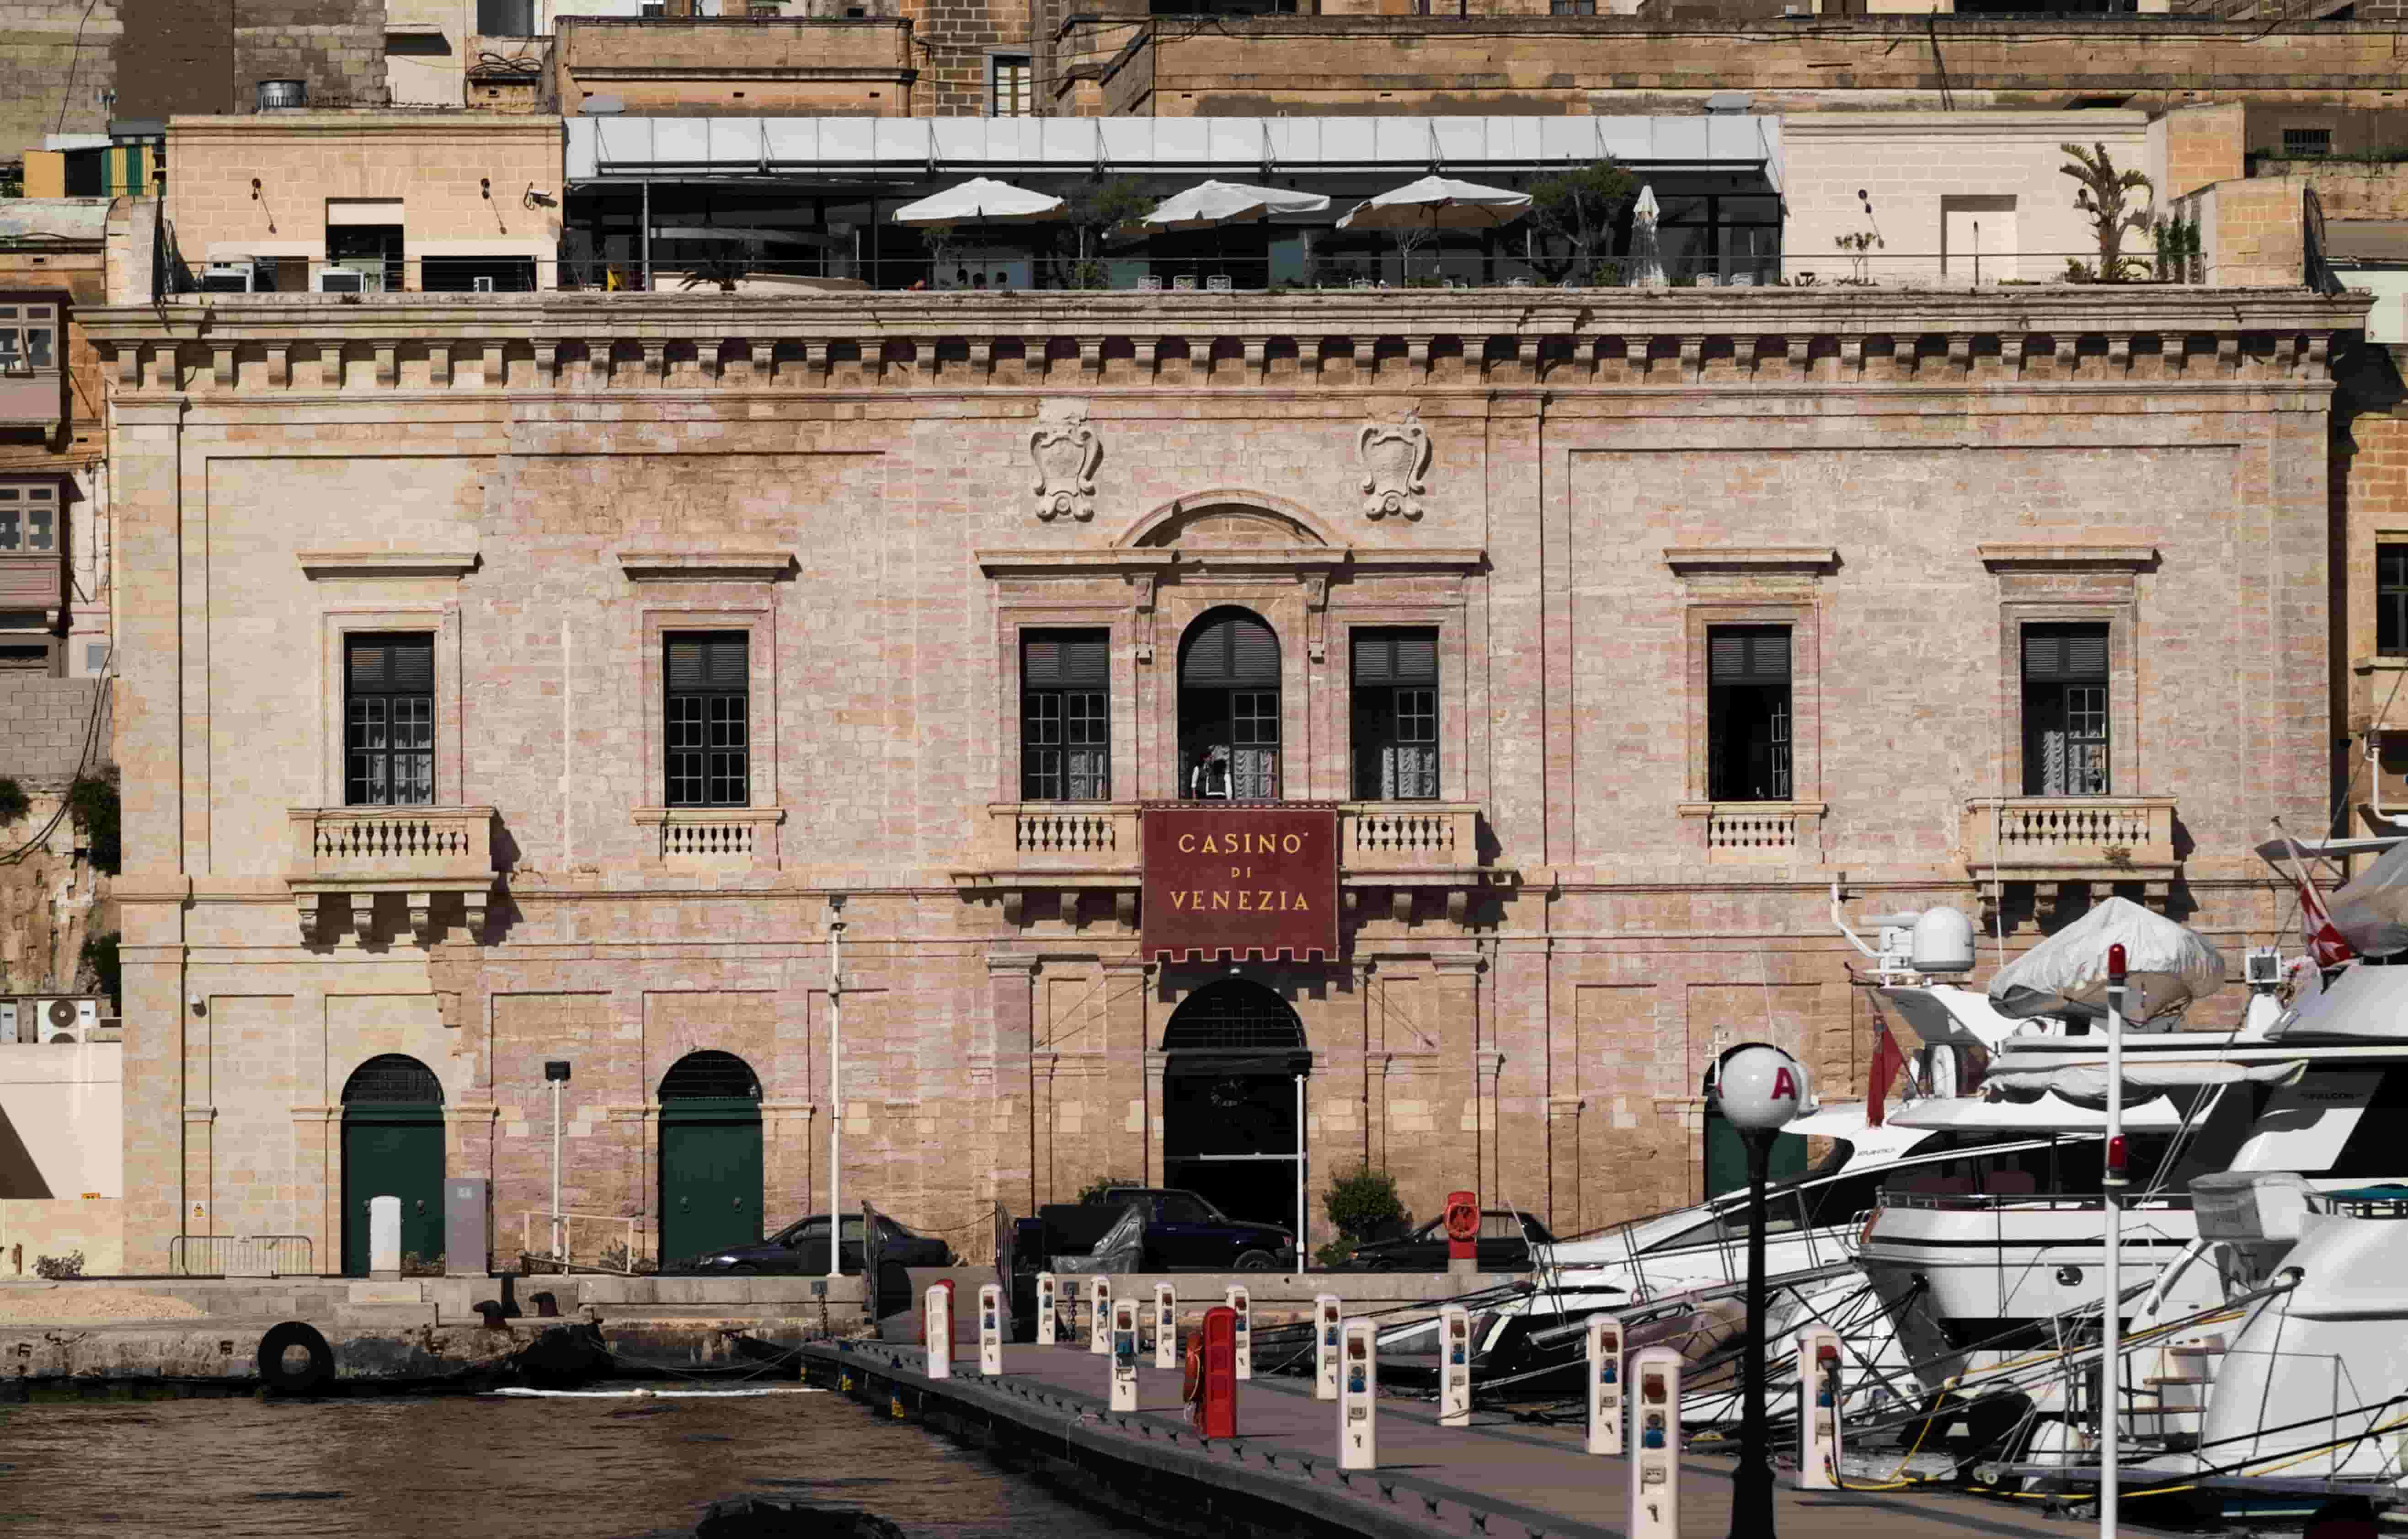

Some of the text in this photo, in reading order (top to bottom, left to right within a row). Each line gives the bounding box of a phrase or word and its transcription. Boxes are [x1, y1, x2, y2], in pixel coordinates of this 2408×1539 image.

[1231, 866, 1251, 878] DI
[1169, 890, 1309, 911] VENEZIA
[1770, 1067, 1797, 1101] A
